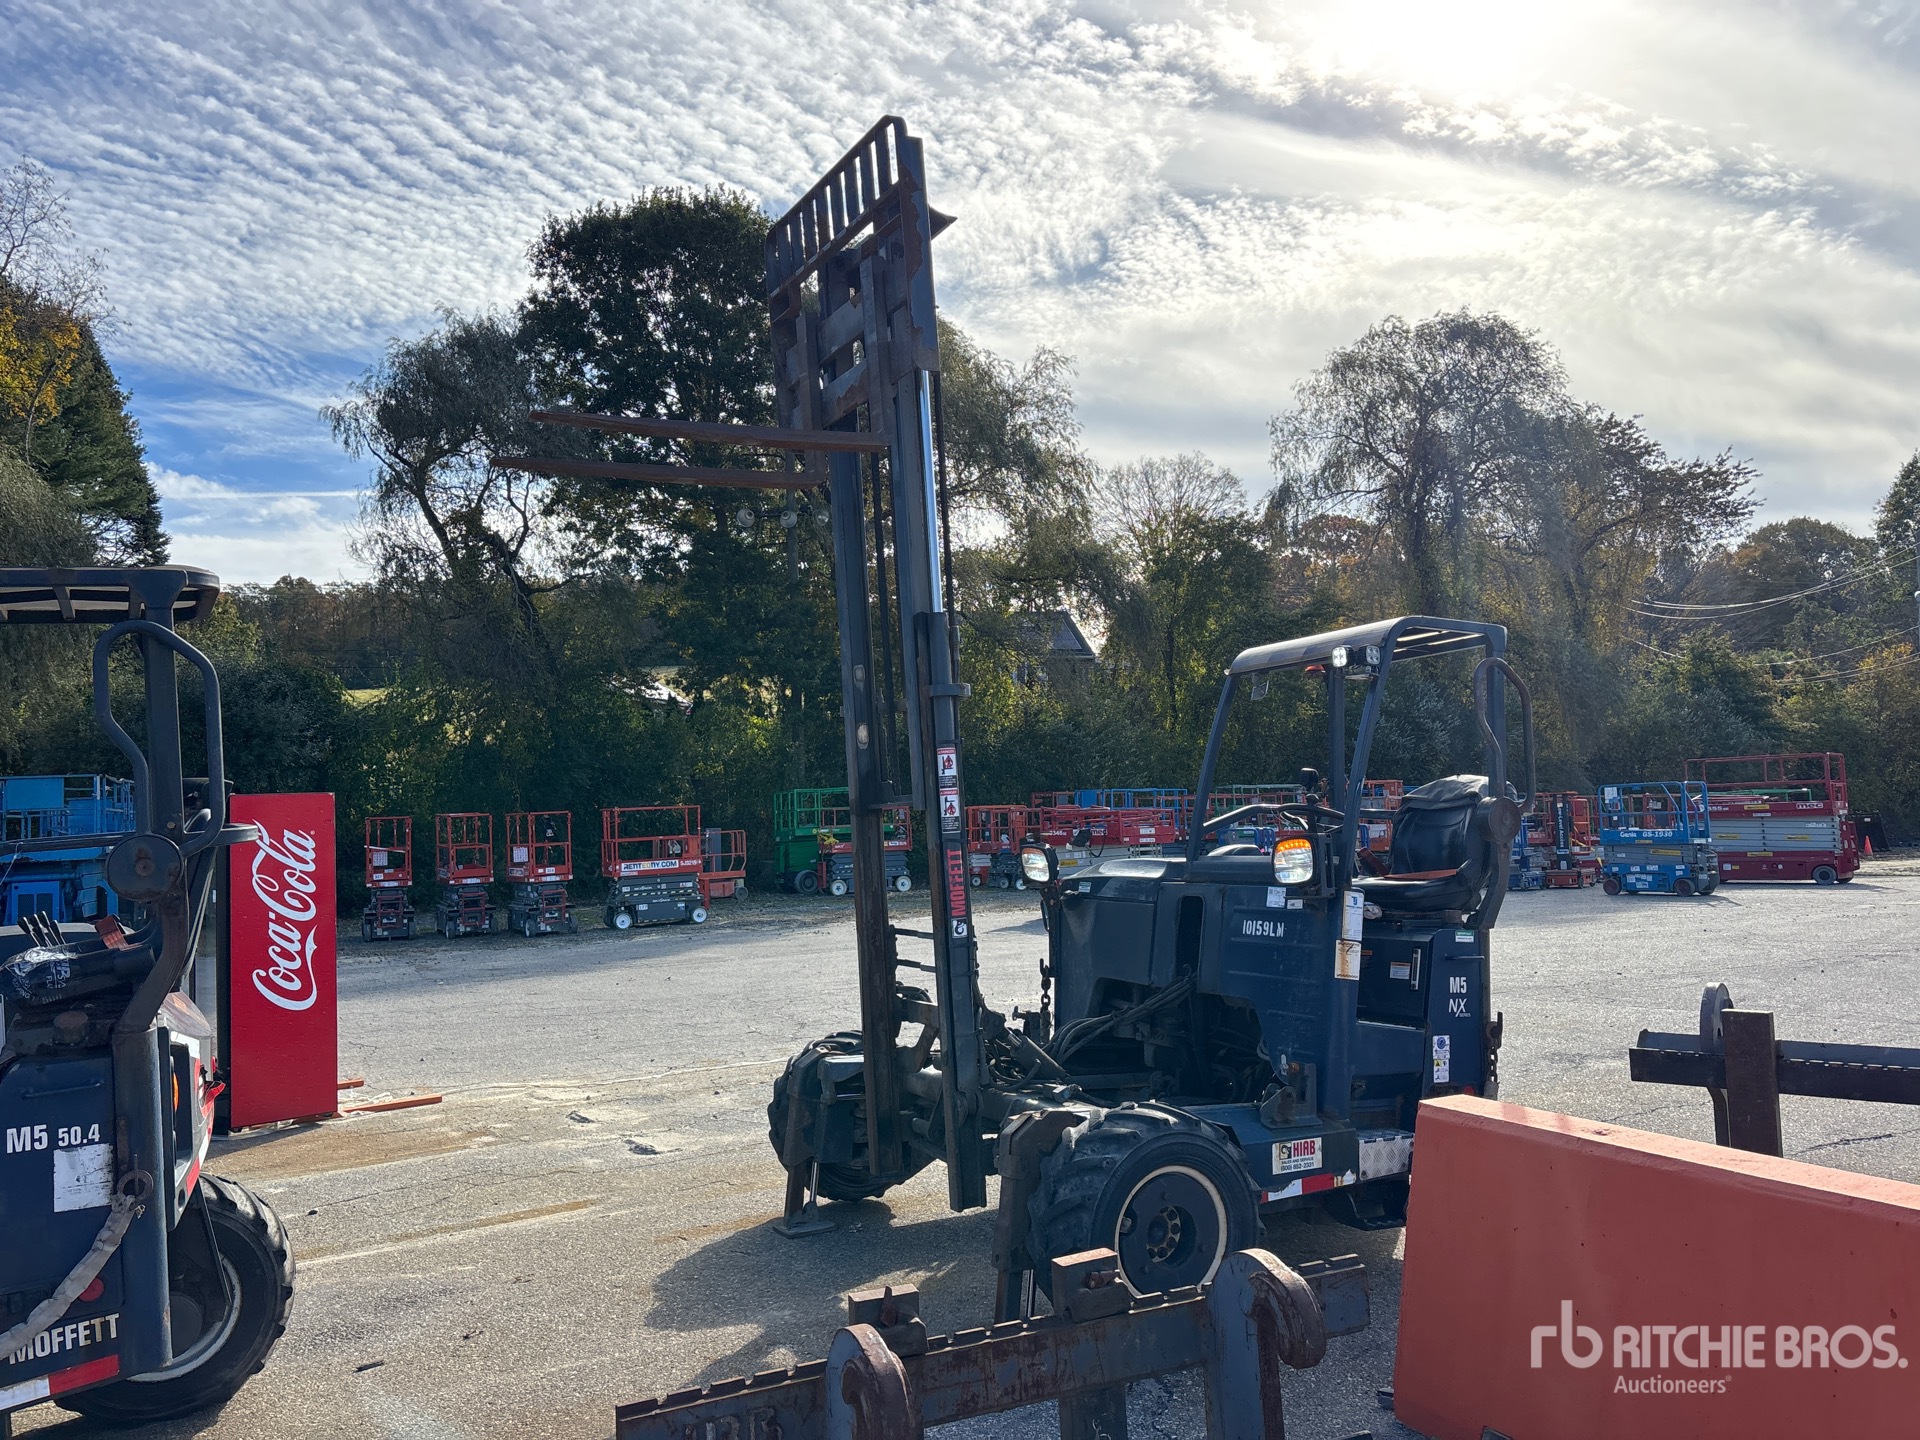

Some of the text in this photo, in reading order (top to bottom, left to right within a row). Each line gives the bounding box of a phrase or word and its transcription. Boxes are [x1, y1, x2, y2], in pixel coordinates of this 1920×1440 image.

[946, 848, 967, 917] MOFFETT
[252, 818, 317, 1011] Coca-Cola
[1449, 976, 1467, 994] M5
[1448, 998, 1468, 1018] NX
[6, 1123, 101, 1154] M5 50.4
[1293, 1140, 1316, 1157] HIAB
[9, 1313, 120, 1365] MOFFETT
